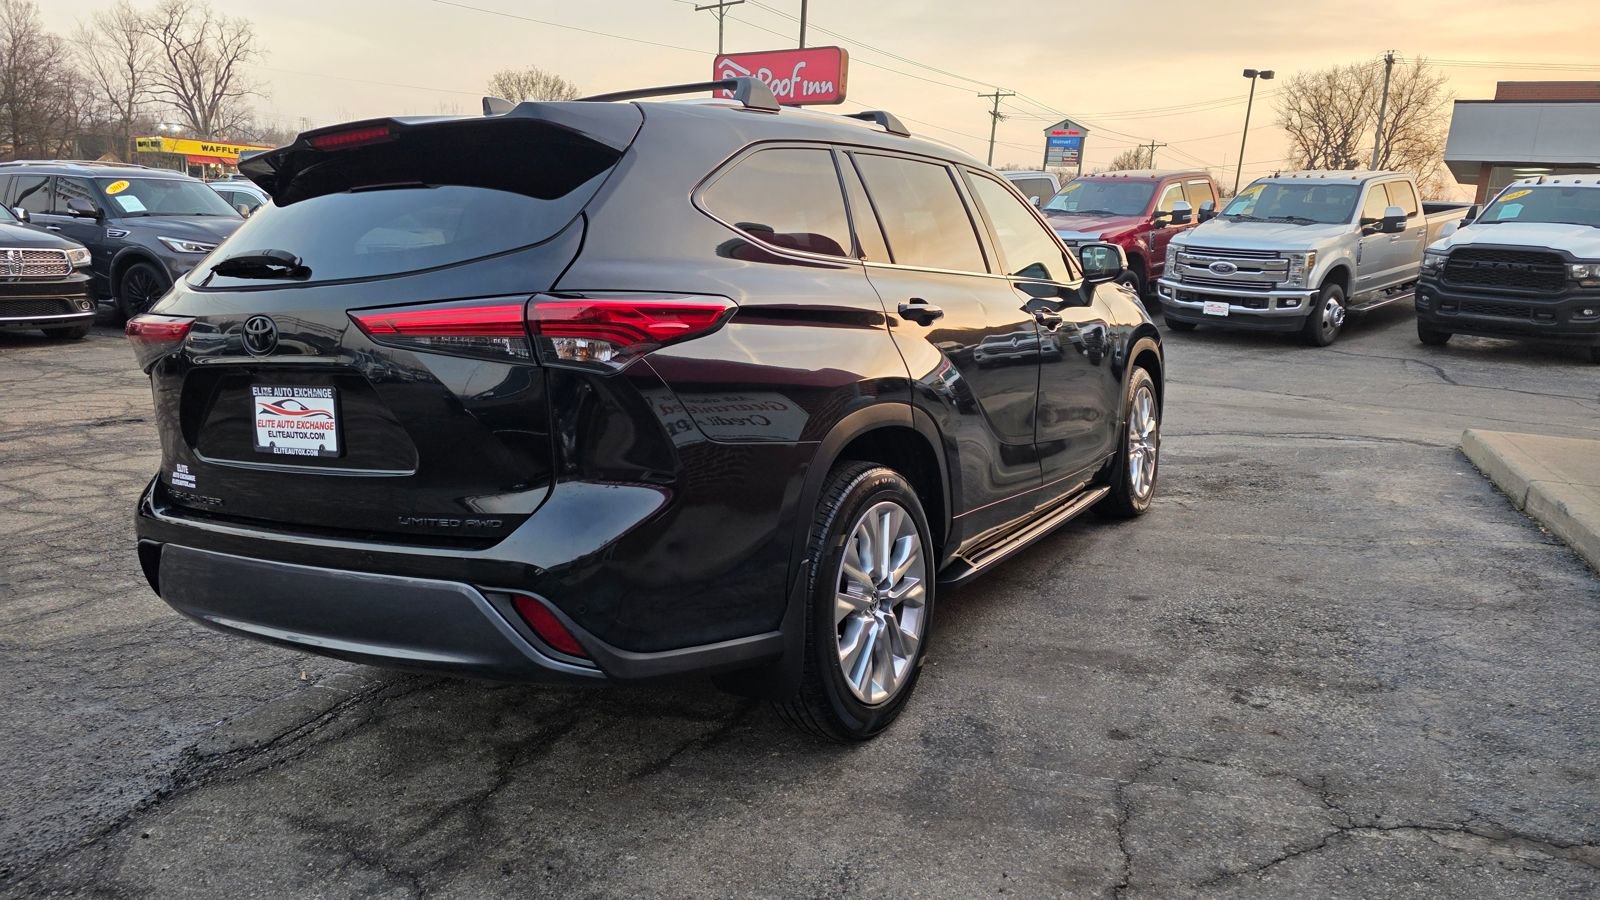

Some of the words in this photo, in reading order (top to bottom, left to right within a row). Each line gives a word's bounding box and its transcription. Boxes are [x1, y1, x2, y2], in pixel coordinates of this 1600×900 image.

[757, 61, 806, 98] Roof
[201, 144, 240, 154] WAFFLE
[252, 386, 272, 396] ELITE
[274, 387, 293, 397] AUTO
[293, 388, 332, 398] EXCHANGE
[257, 420, 276, 428] ELITE
[276, 421, 295, 429] AUTO
[296, 421, 335, 431] EXCHANGE
[268, 430, 326, 441] ELITEAUTOX.COM
[273, 447, 319, 457] ELITEAUTOX.COM
[398, 516, 461, 528] LIMITED
